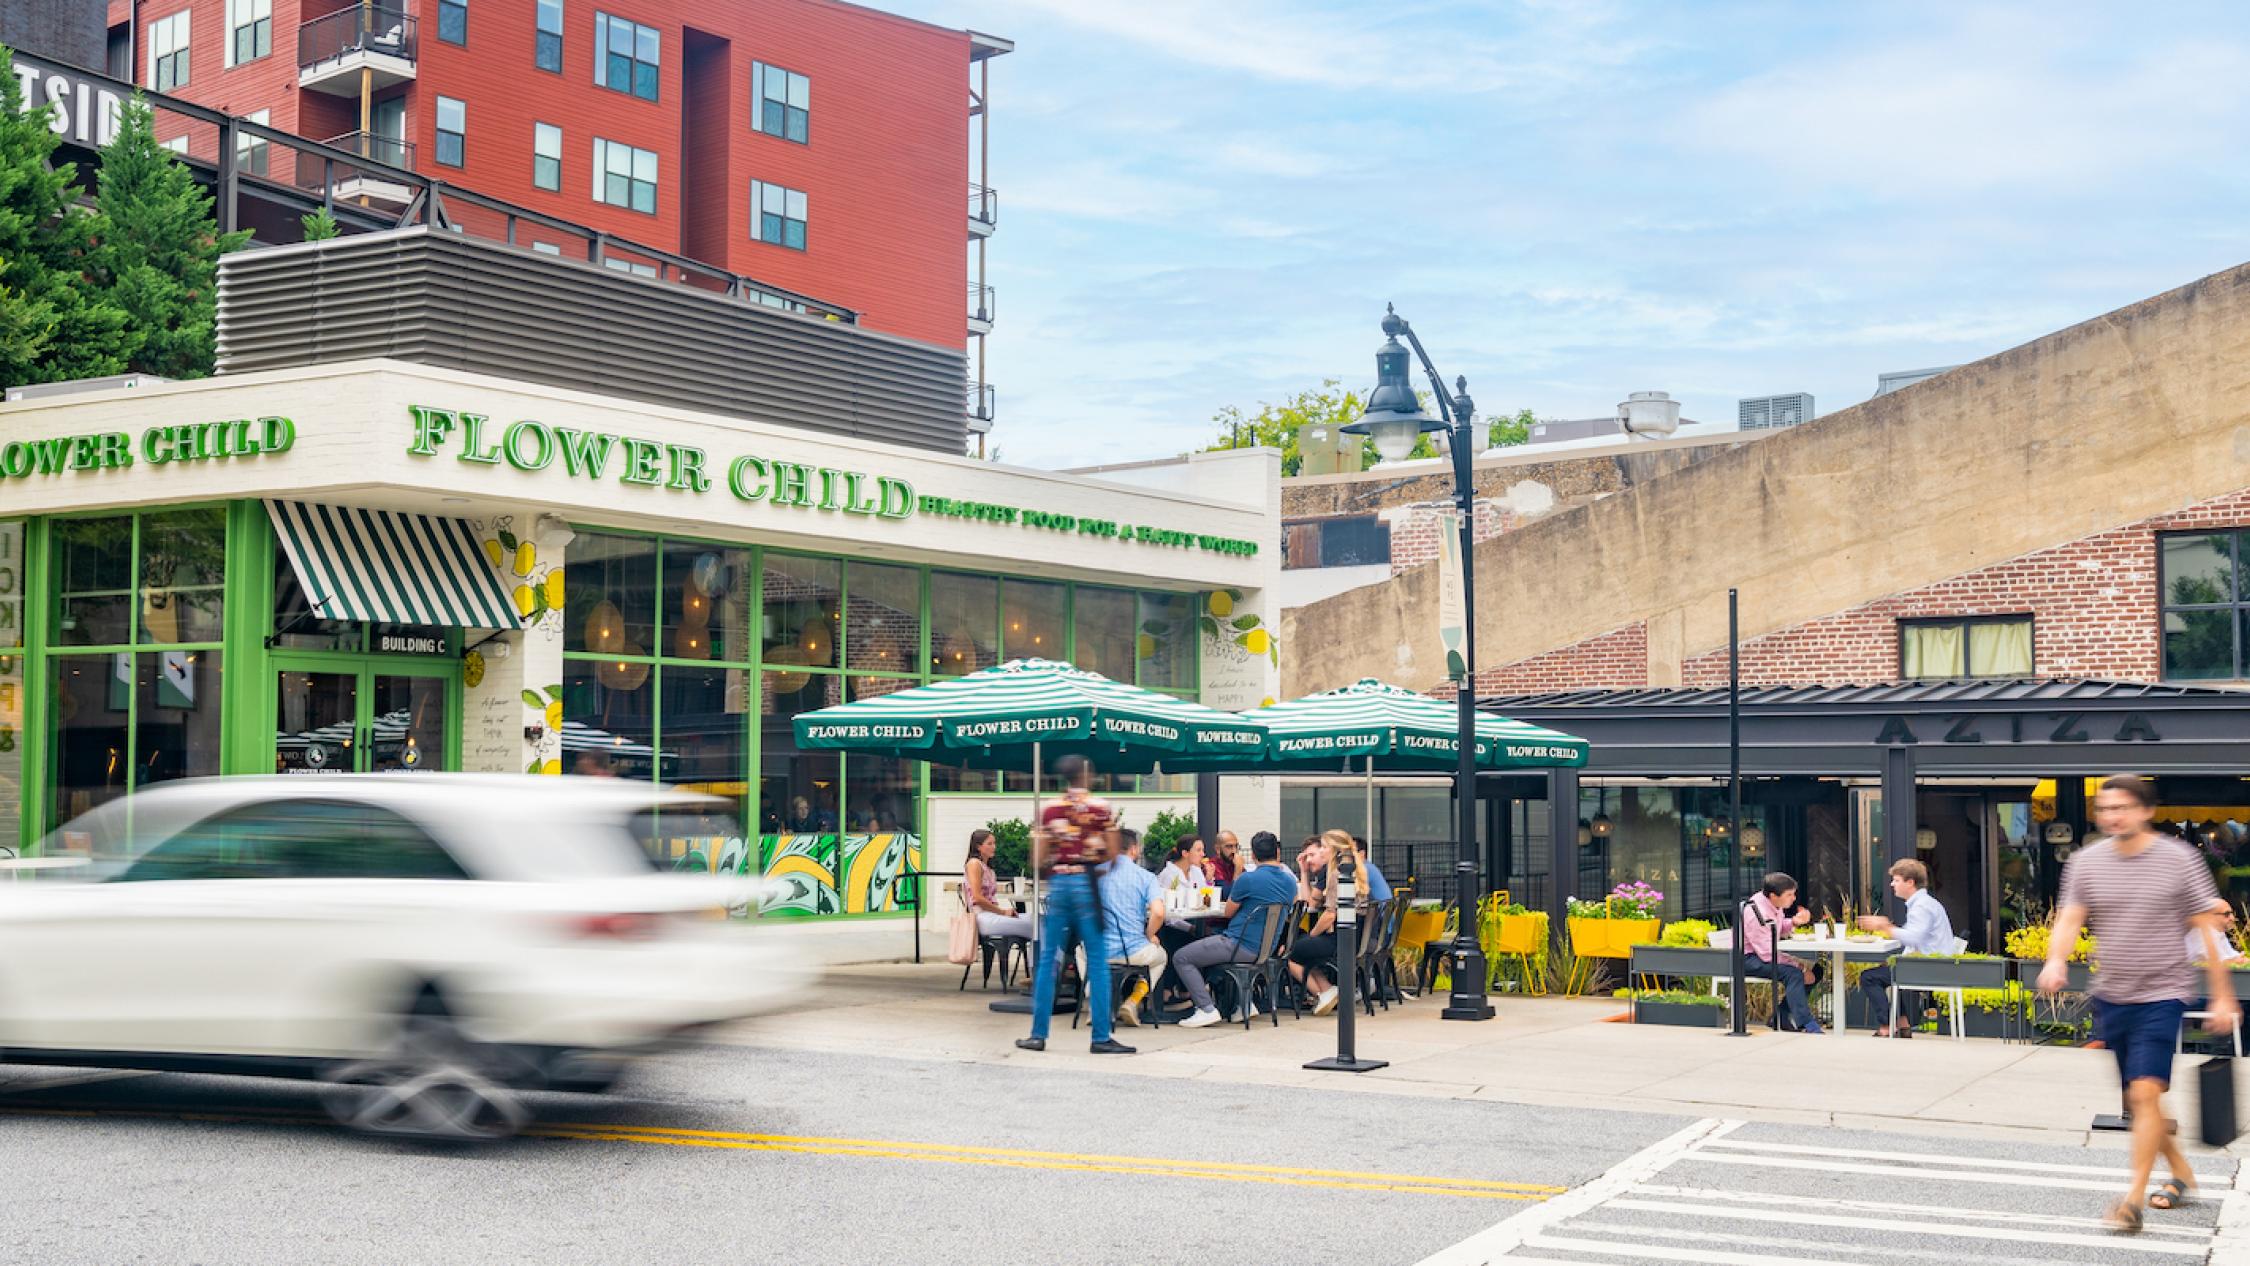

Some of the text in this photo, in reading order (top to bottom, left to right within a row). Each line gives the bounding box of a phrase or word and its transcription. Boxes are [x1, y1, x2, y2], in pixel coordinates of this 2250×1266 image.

[13, 63, 150, 147] TSID
[0, 416, 297, 478] OWER CHILD
[407, 403, 918, 520] FLOWER CHILD
[1022, 510, 1077, 531] FOOD
[1078, 518, 1117, 537] FOR
[1119, 525, 1136, 541] A
[382, 636, 446, 653] BUILDING C
[807, 725, 925, 738] FLOWER CHILD
[956, 717, 1080, 737] FLOWER CHILD
[1104, 718, 1178, 740] FLOWER CHILD
[1874, 711, 2161, 744] AZIZA
[1197, 730, 1262, 745] FLOWER CHILD
[1279, 734, 1380, 751] FLOWER CHILD
[1404, 735, 1450, 751] FLOWER
[1506, 746, 1579, 760] FLOWER CHILD
